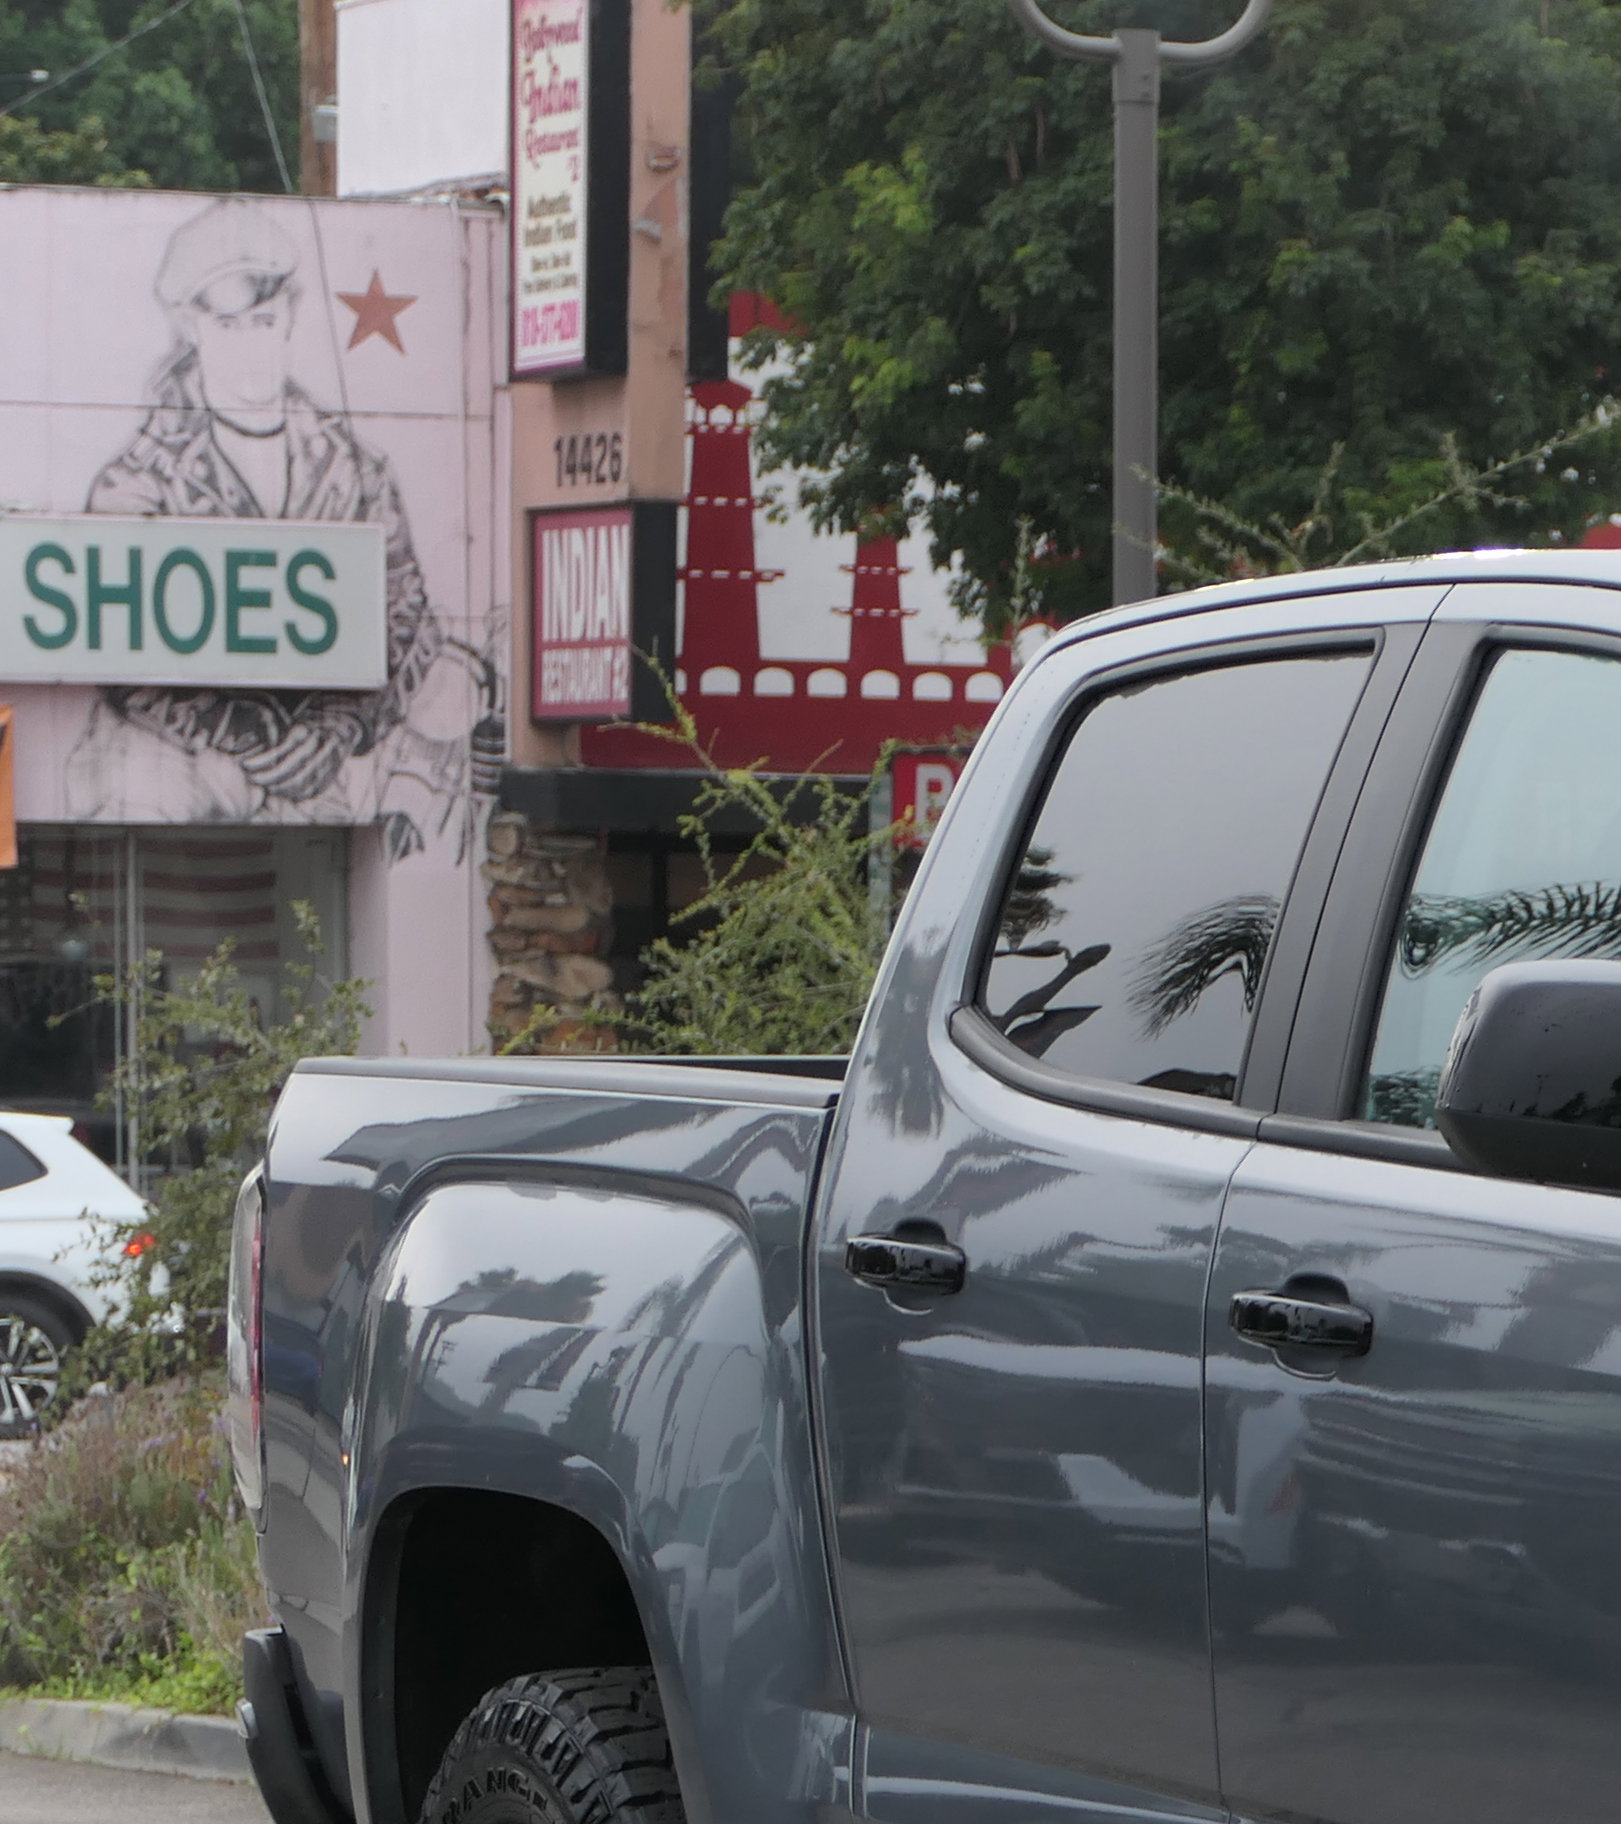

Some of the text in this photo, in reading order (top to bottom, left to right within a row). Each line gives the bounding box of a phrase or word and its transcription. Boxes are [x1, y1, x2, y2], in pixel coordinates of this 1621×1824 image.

[554, 432, 622, 487] 14426
[23, 540, 339, 655] SHOES
[542, 524, 630, 643] INDIAN
